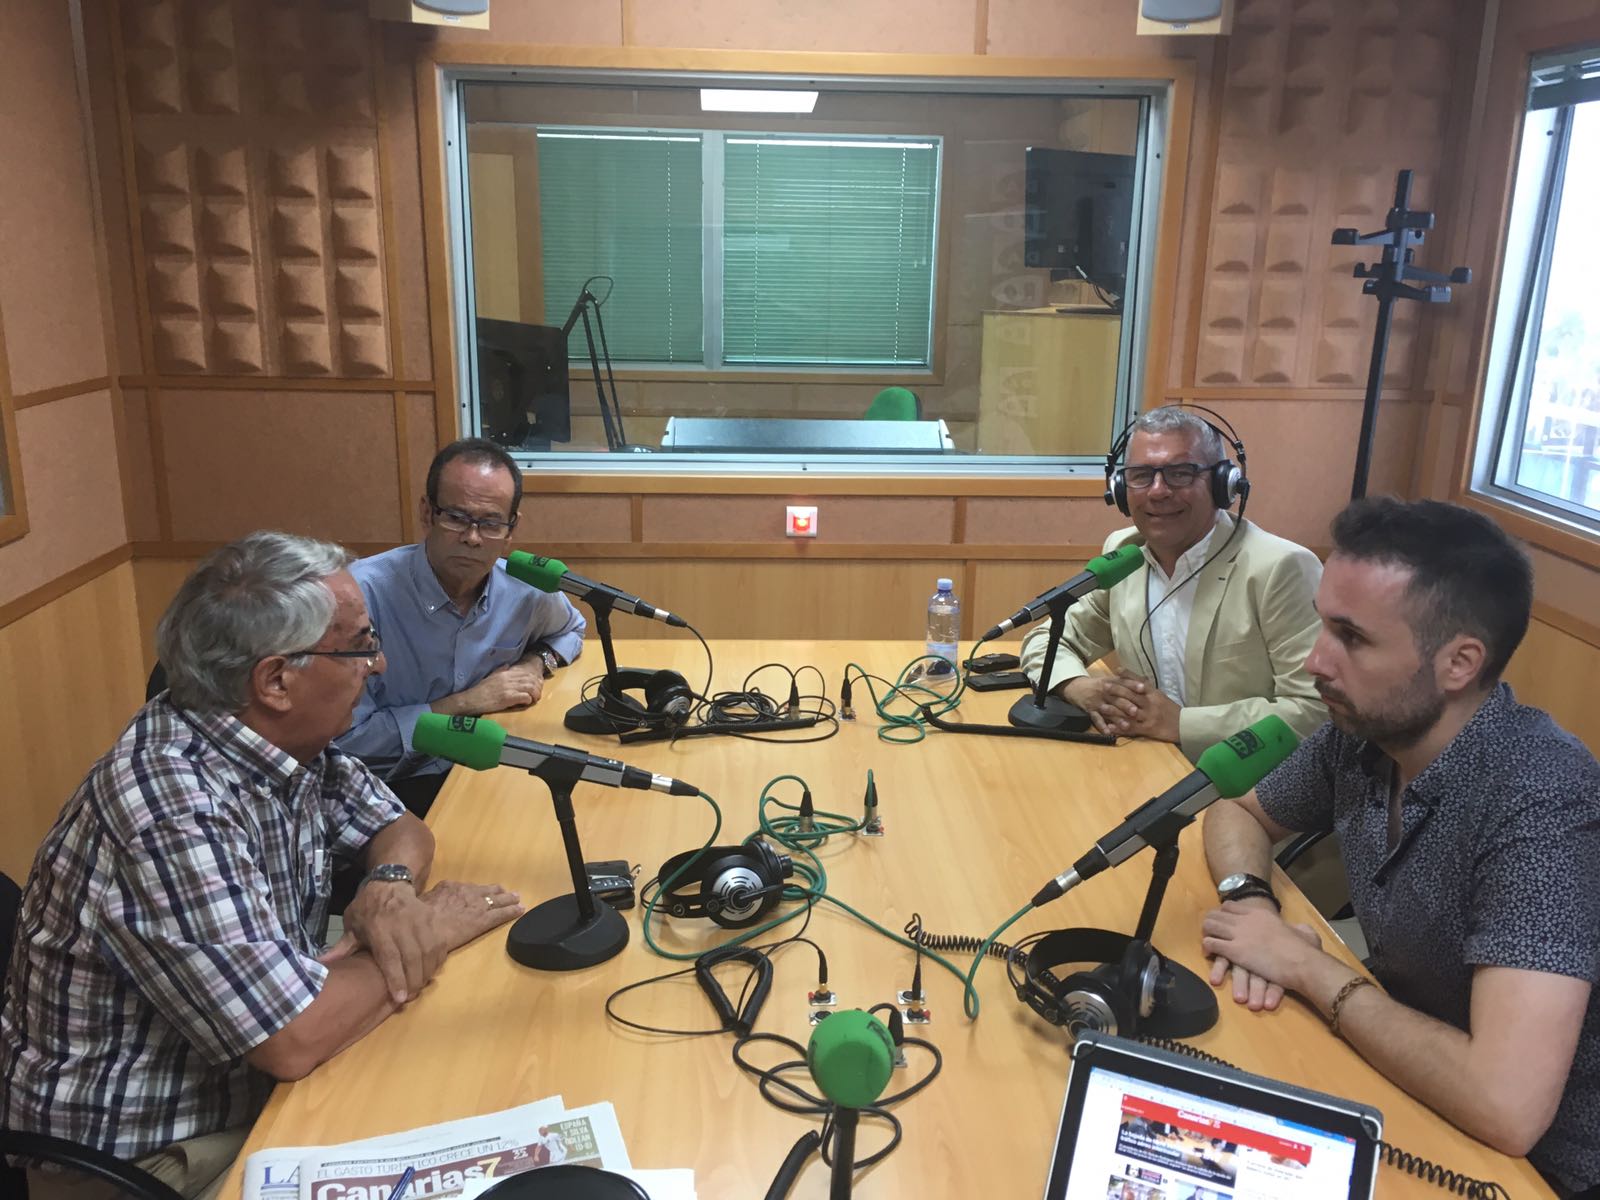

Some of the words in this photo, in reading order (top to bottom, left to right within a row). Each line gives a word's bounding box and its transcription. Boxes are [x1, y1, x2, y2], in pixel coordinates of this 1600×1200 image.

[334, 1164, 373, 1176] GASTO
[440, 1149, 471, 1163] CRECE
[477, 1143, 494, 1155] UN
